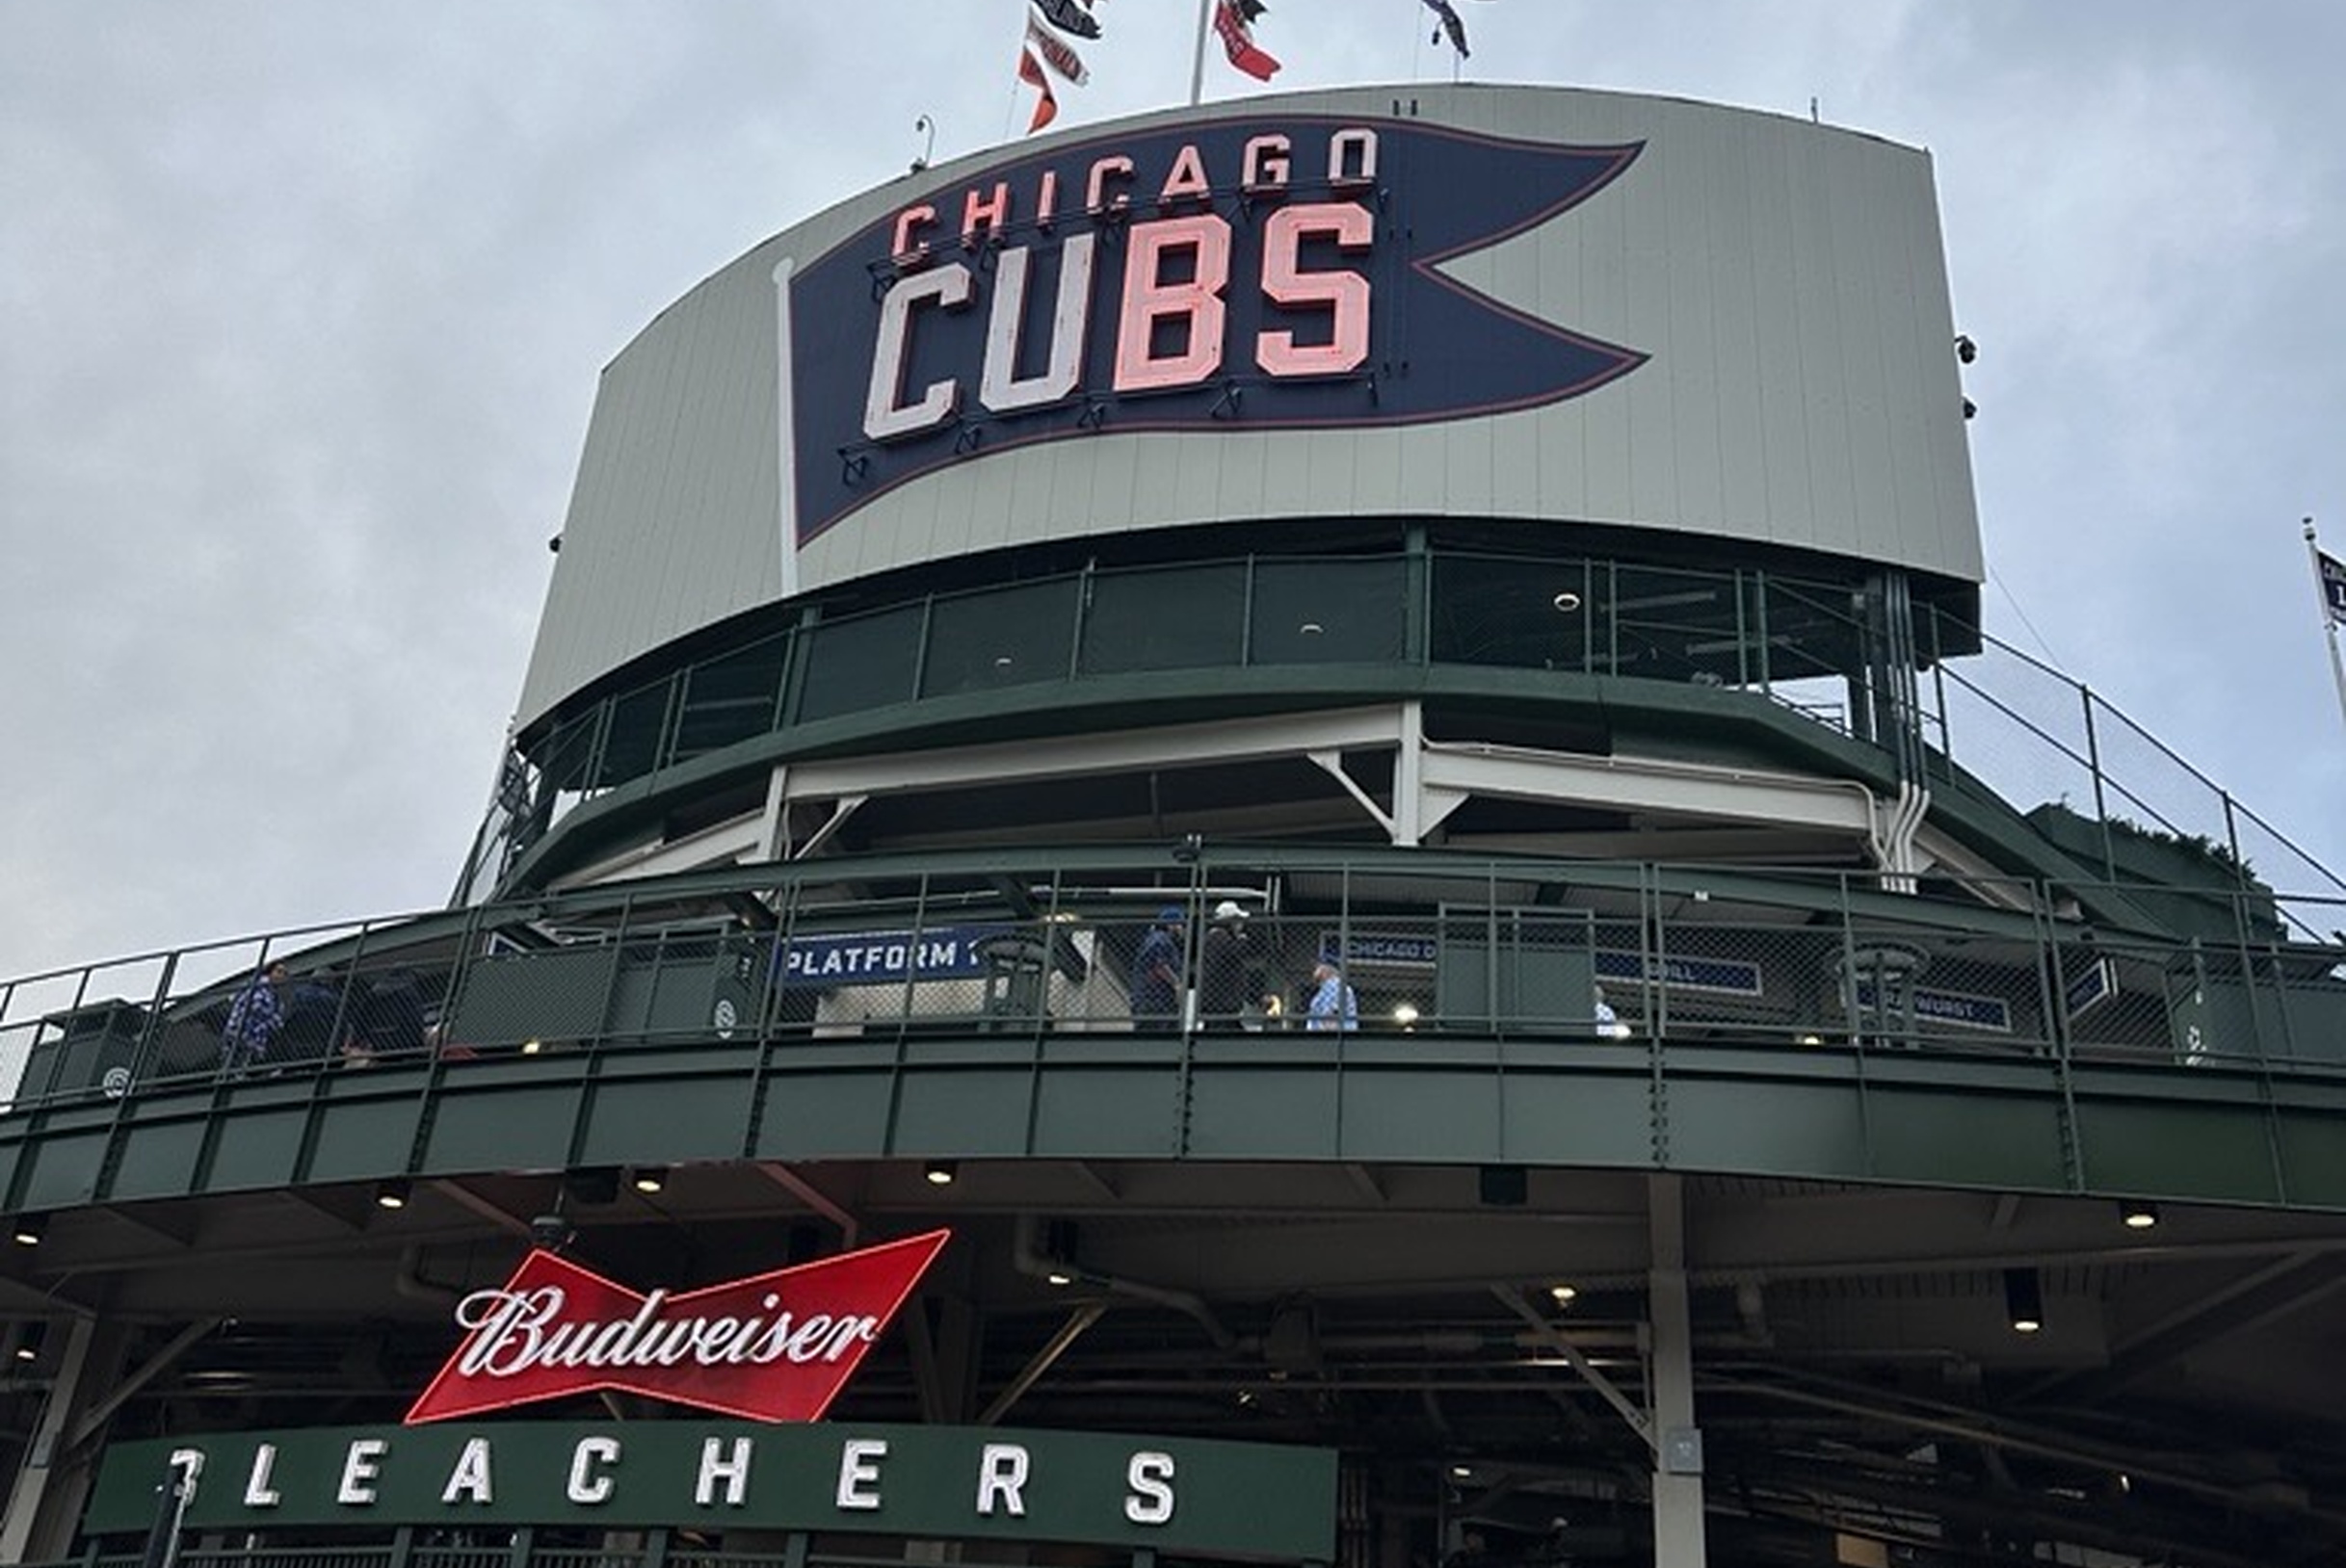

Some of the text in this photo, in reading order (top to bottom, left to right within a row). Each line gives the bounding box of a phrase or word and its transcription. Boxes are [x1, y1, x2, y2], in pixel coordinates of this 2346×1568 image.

[889, 129, 1379, 267] CHICAGO
[862, 202, 1375, 441] CUBS
[786, 941, 957, 975] PLATFORM
[455, 1286, 879, 1378] Budweiser
